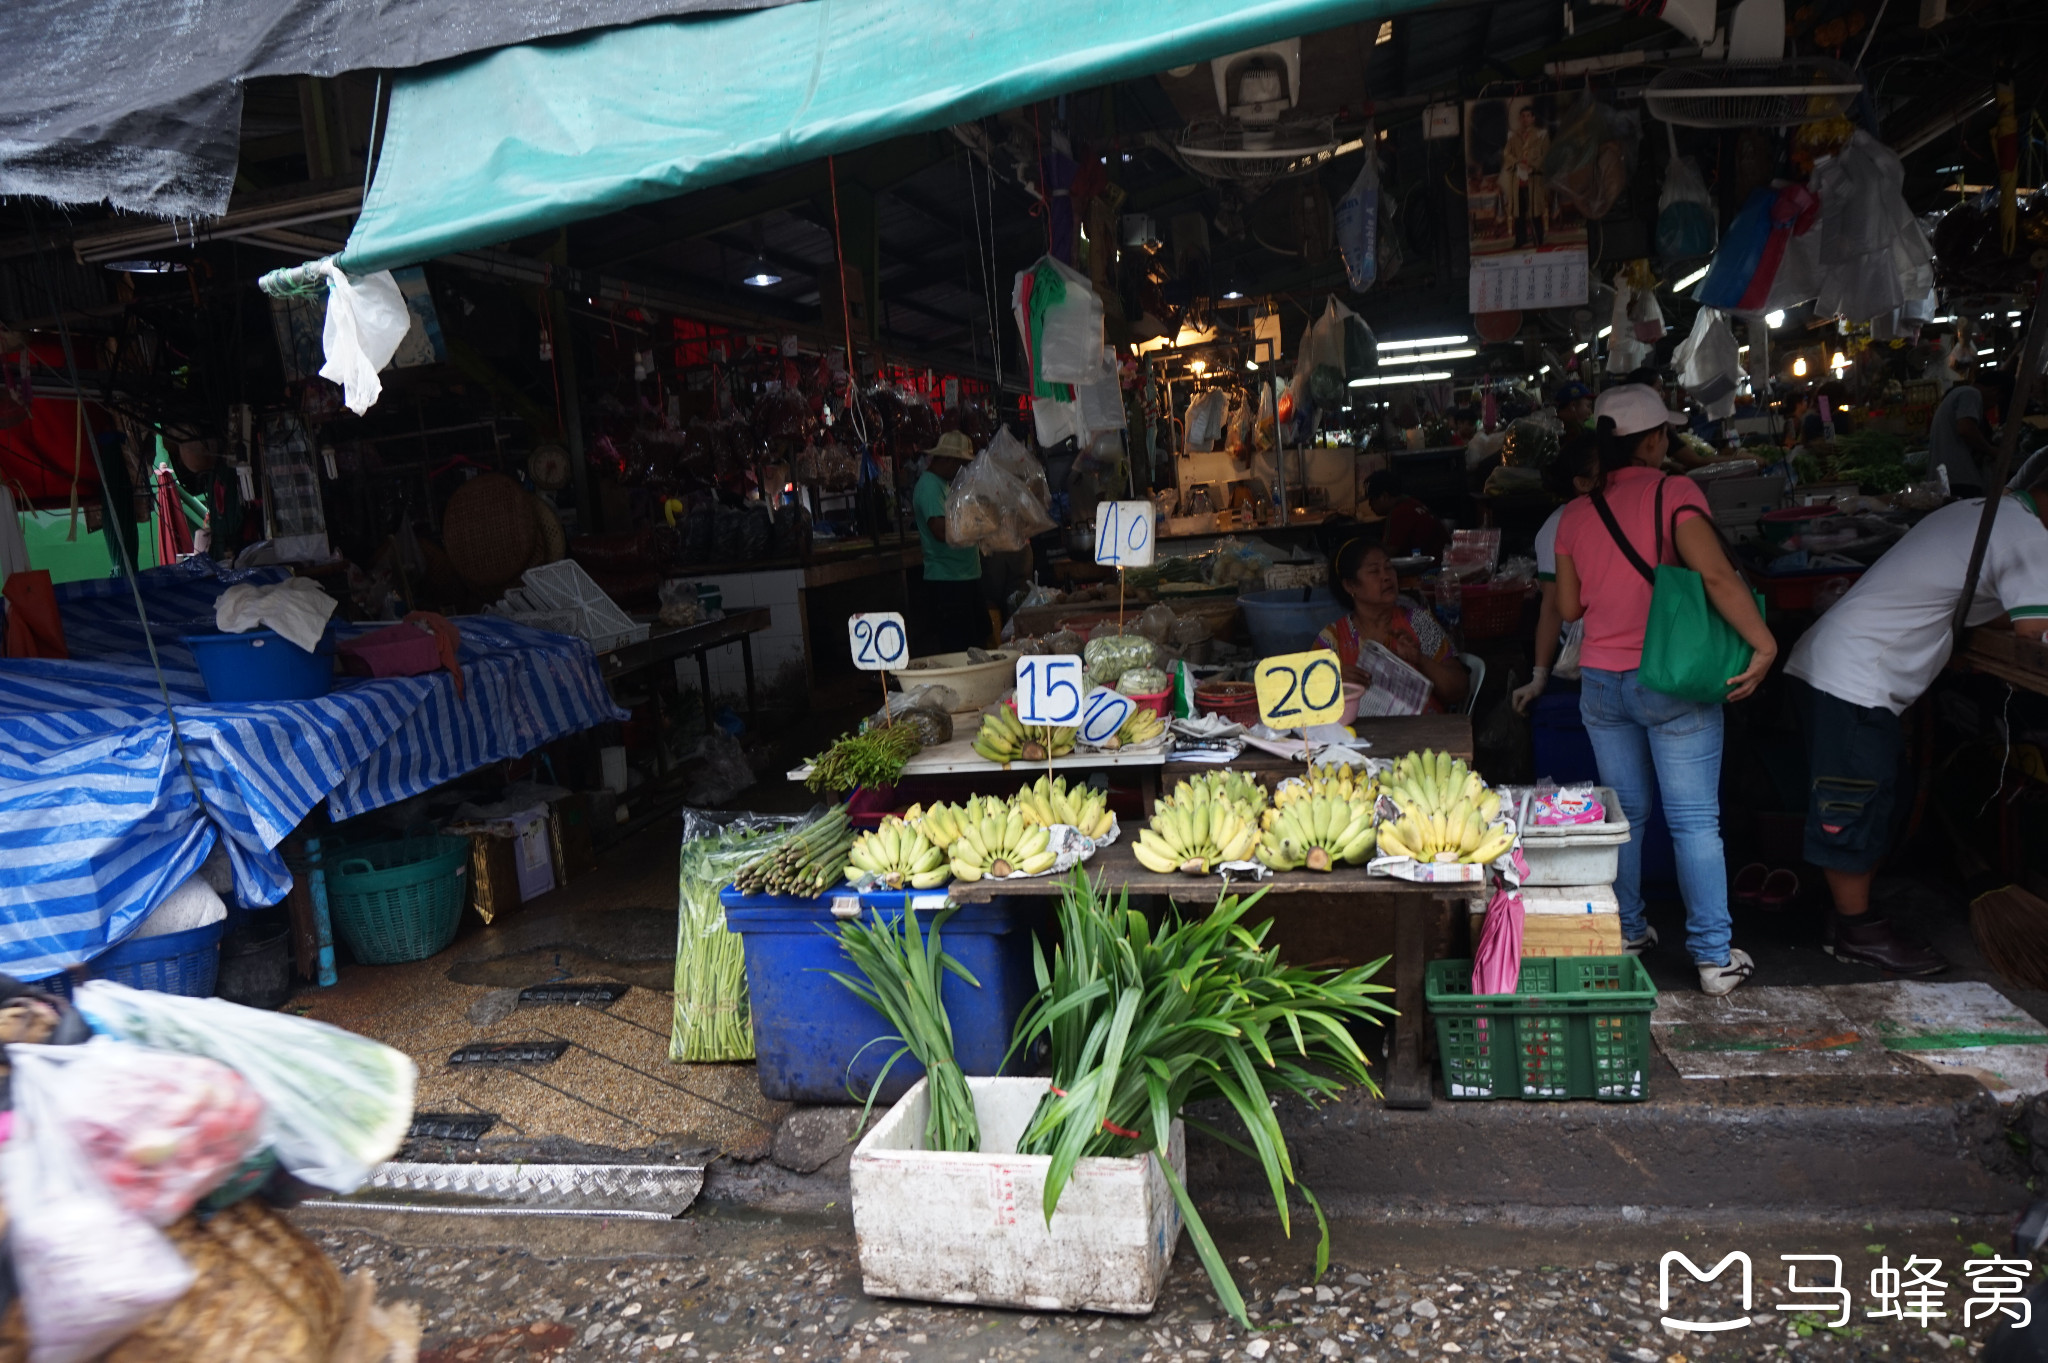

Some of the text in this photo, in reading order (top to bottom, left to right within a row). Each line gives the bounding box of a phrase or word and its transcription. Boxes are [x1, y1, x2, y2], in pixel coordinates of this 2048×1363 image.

[855, 620, 905, 662] 20
[1020, 661, 1080, 721] 15
[1265, 659, 1341, 718] 20
